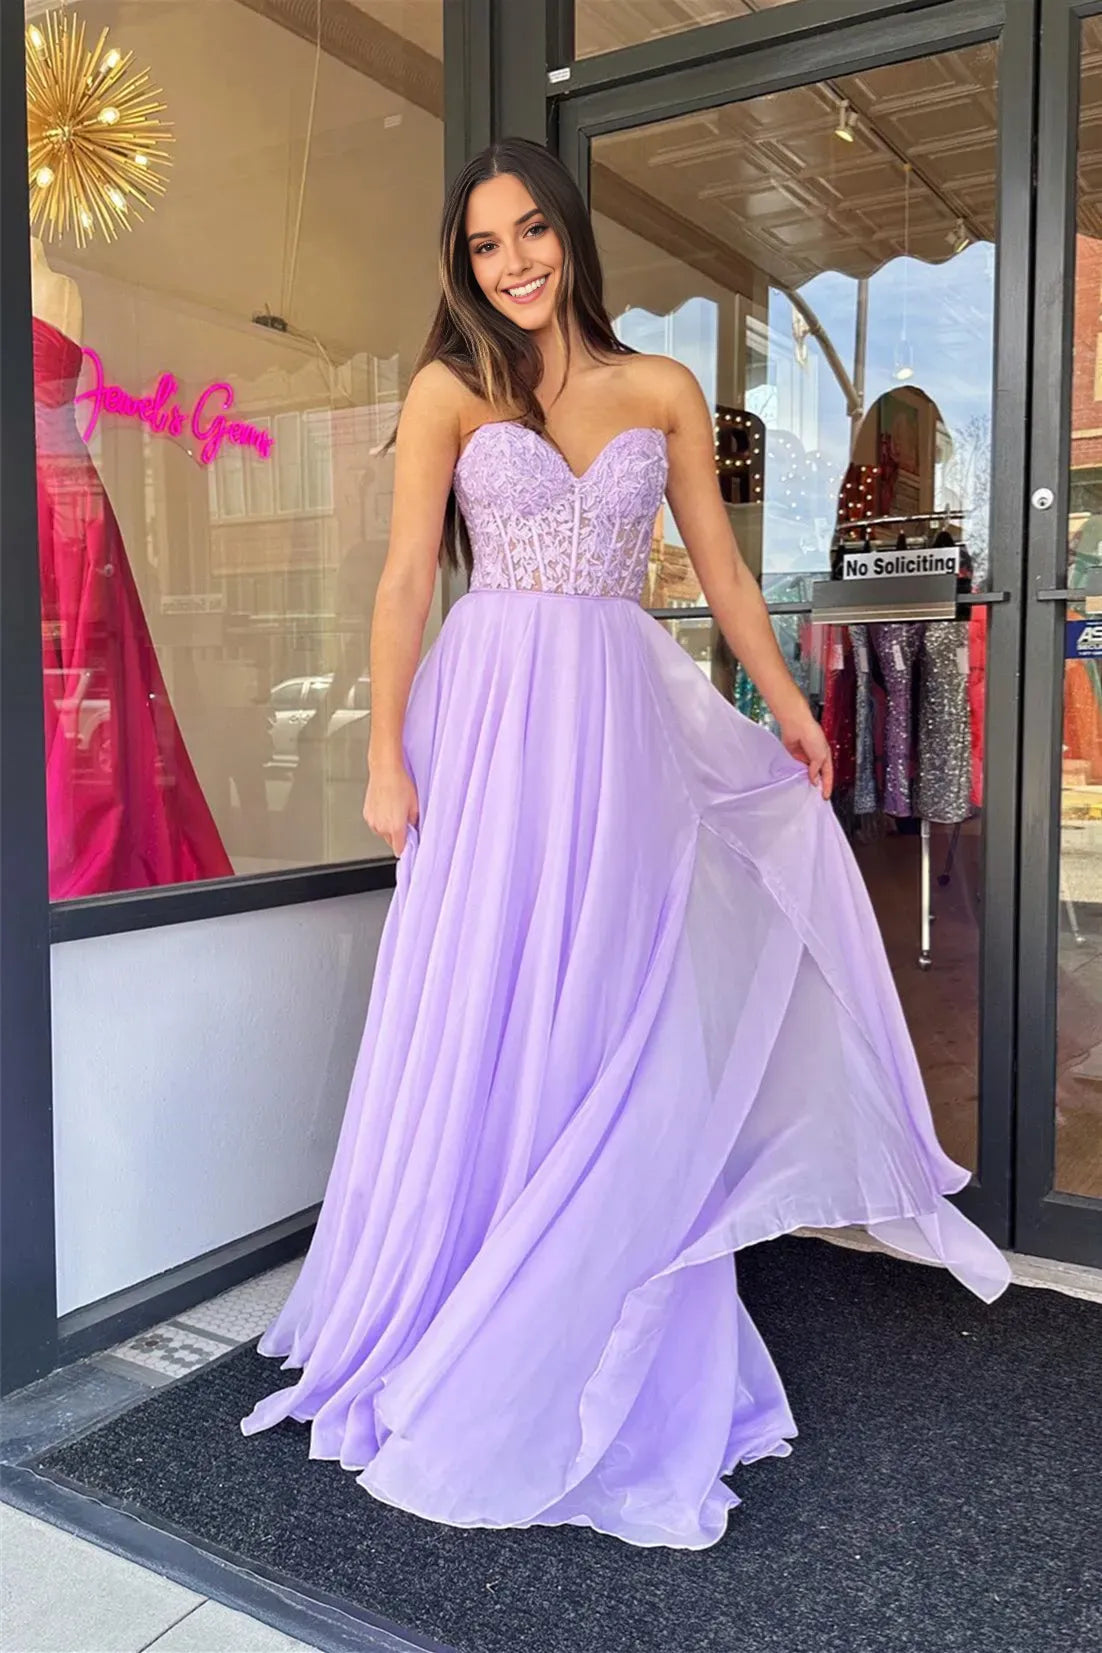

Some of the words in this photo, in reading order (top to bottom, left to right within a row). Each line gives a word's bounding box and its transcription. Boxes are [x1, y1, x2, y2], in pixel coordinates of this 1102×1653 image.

[192, 383, 273, 464] Gems
[846, 559, 868, 577] No
[873, 554, 956, 575] Soliciting
